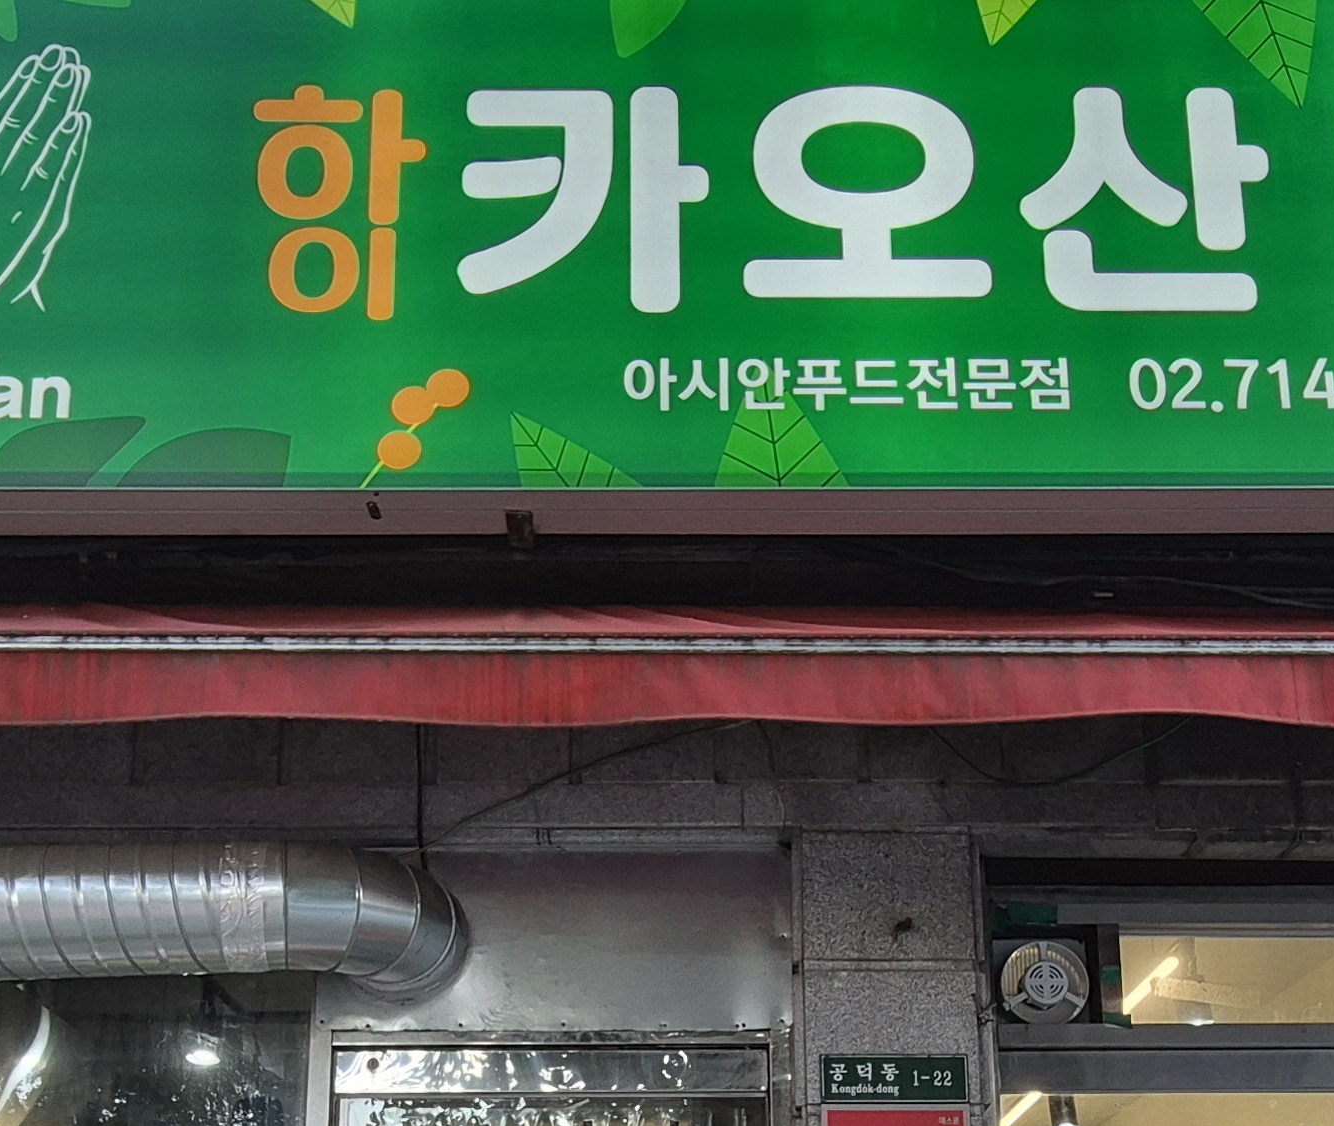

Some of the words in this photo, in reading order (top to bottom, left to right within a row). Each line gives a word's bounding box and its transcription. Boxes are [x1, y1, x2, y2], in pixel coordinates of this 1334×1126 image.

[254, 85, 426, 320] 하이
[456, 85, 1270, 313] 카오산
[623, 356, 1071, 412] 아시안푸드전문점
[912, 1070, 953, 1087] 1-22
